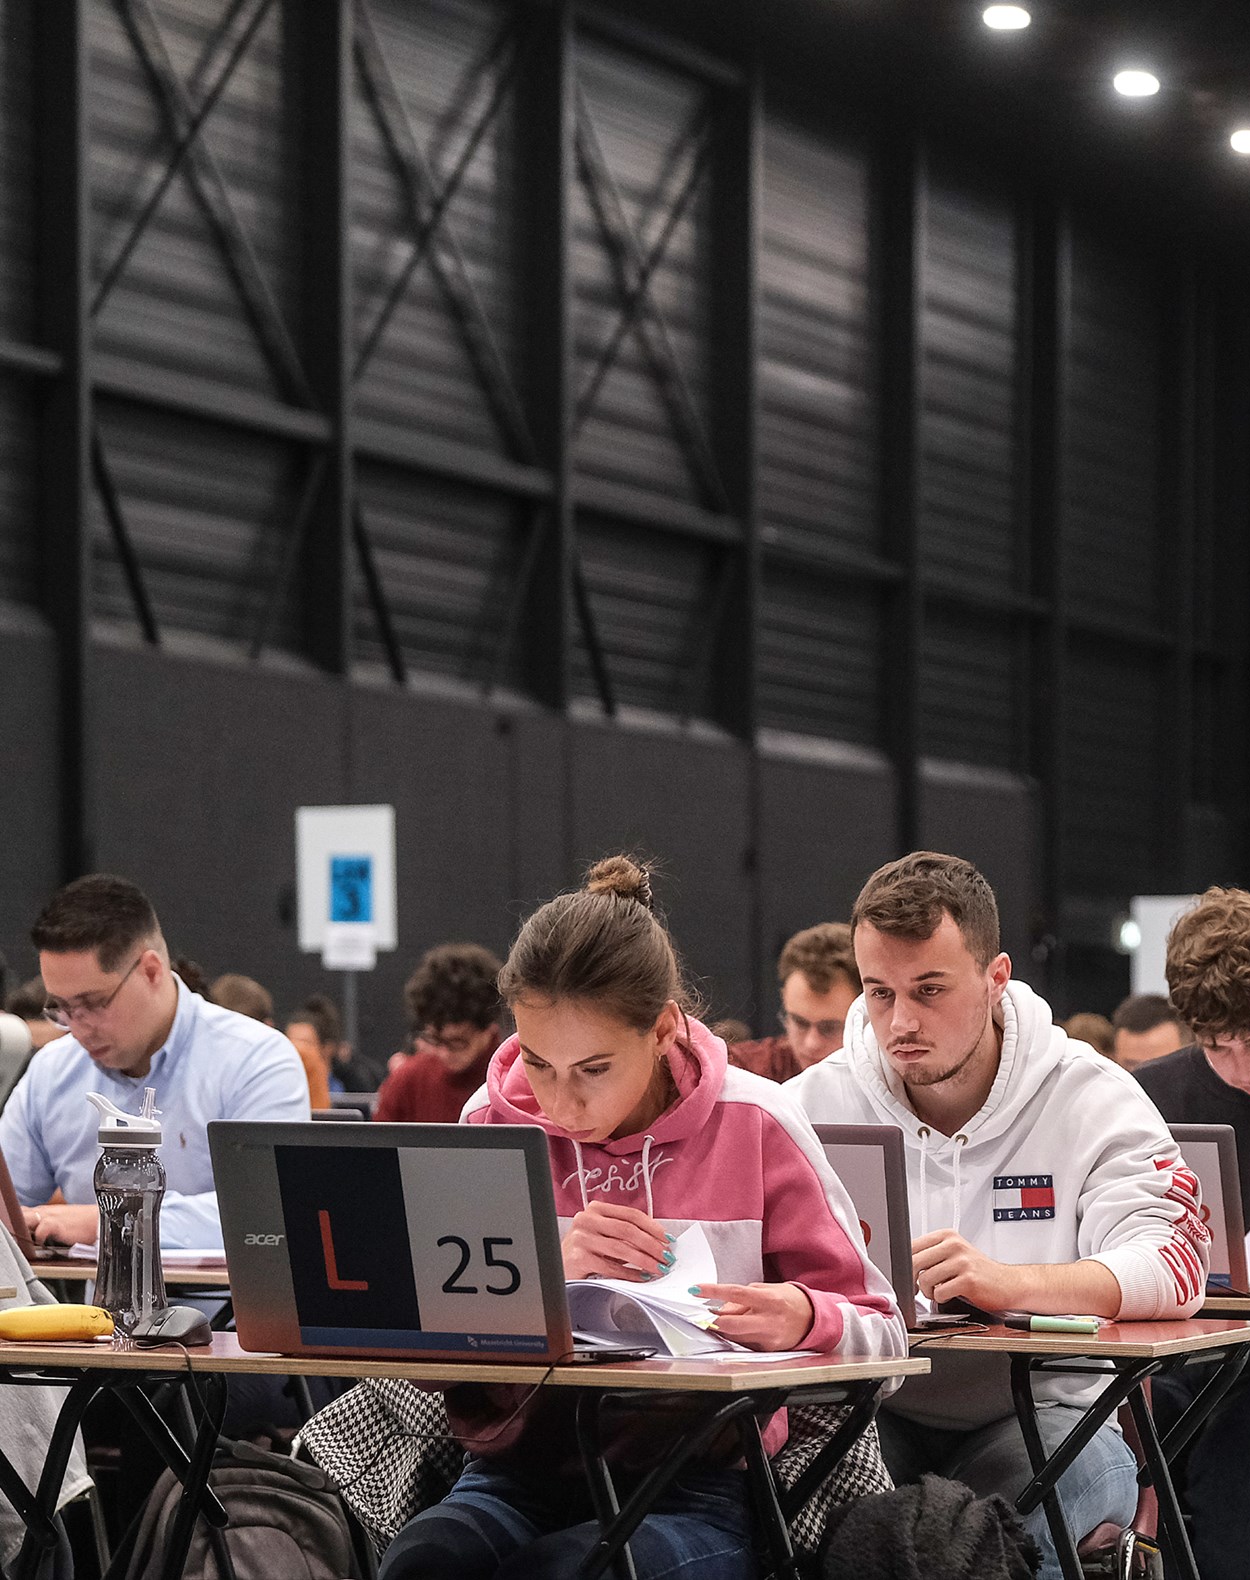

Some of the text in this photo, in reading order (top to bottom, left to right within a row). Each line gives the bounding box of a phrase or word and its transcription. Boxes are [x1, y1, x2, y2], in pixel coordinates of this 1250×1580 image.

[996, 1177, 1049, 1187] TOMMY
[997, 1209, 1051, 1219] JEANS
[244, 1233, 285, 1247] acer
[318, 1209, 522, 1296] L 25
